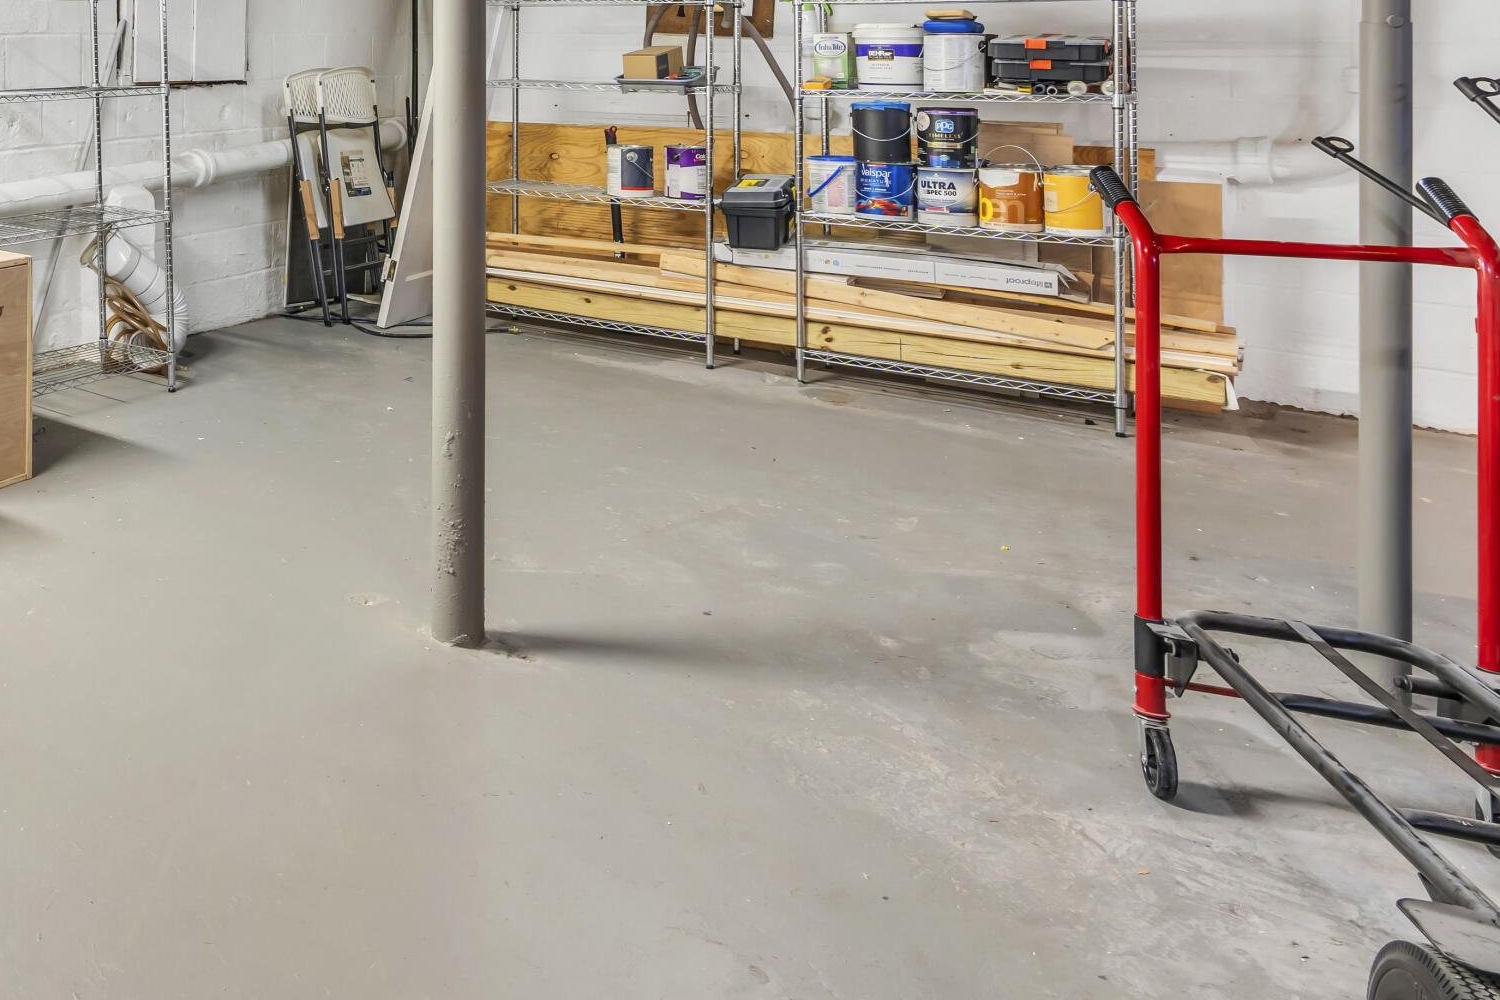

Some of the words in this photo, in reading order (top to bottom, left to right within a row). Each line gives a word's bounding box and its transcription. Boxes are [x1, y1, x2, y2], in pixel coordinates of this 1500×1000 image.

[936, 121, 953, 131] PPG
[861, 167, 892, 178] valspar
[921, 180, 956, 190] ULTRA
[979, 187, 1025, 224] ben
